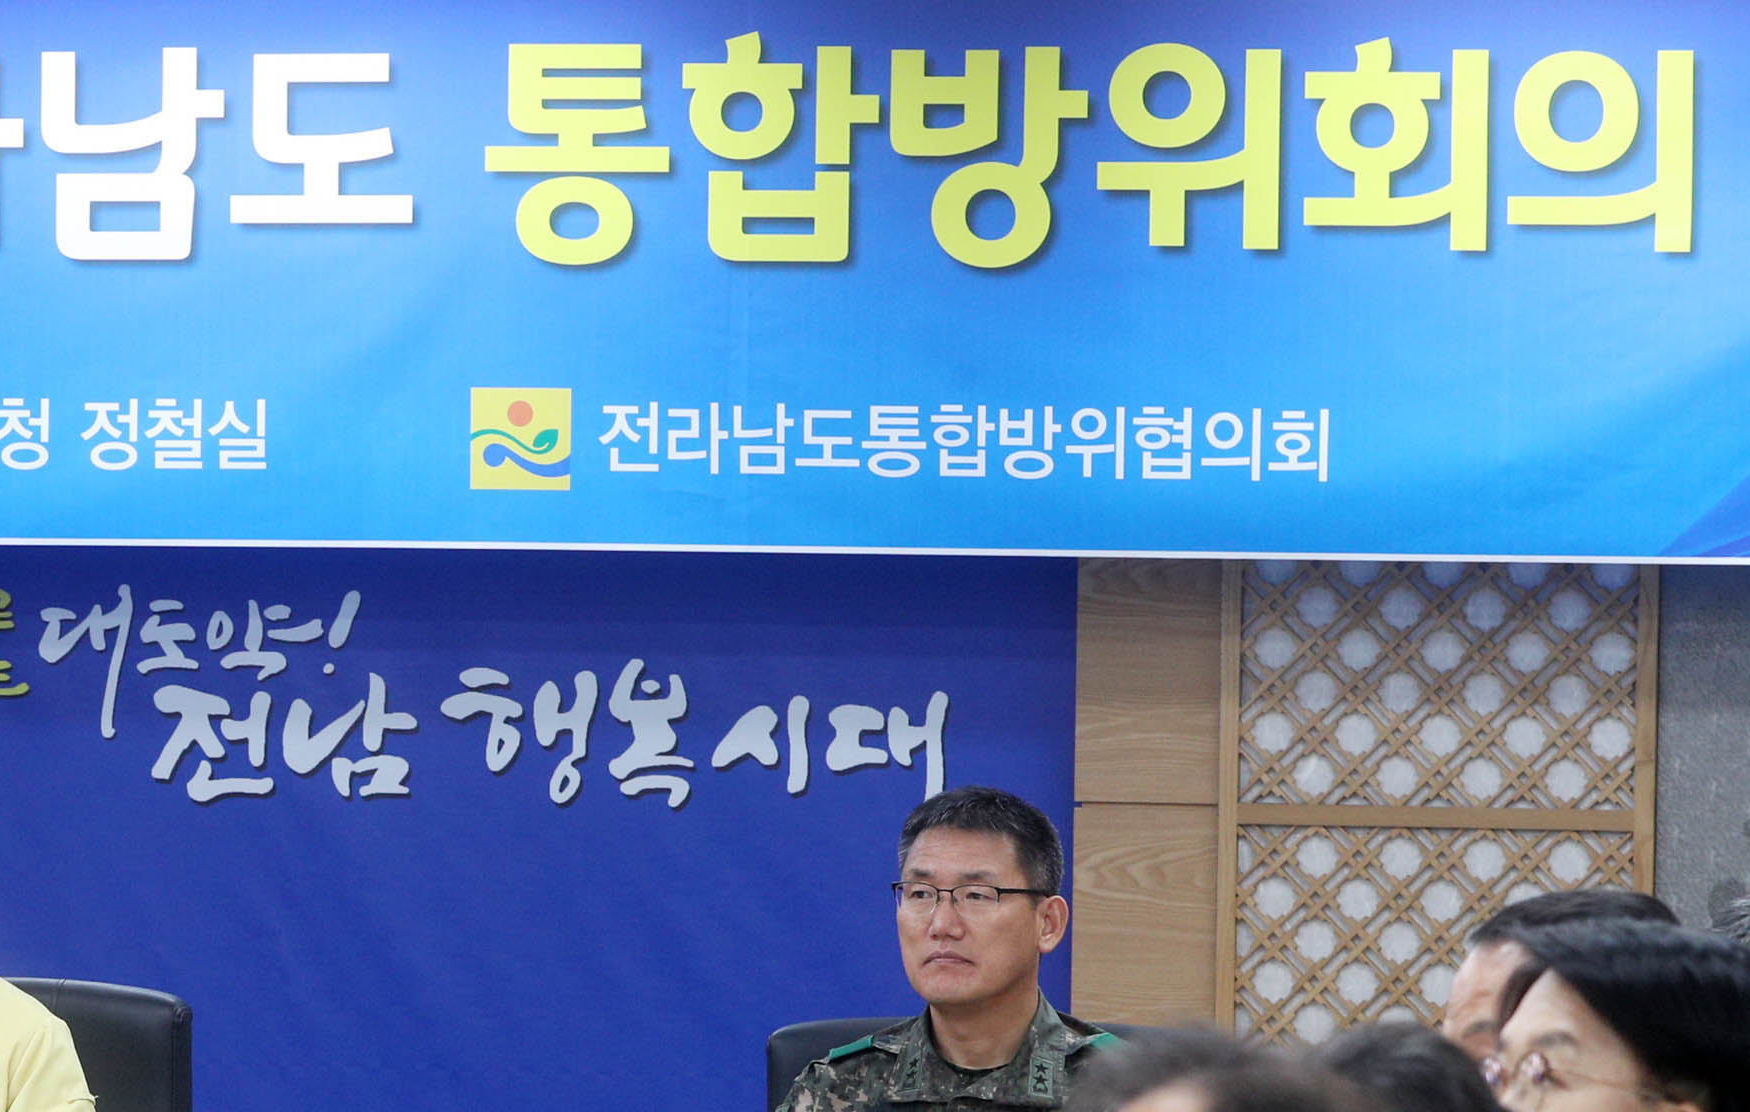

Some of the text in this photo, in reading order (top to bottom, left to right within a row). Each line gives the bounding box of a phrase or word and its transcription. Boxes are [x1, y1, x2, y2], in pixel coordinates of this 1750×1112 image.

[485, 32, 1693, 267] 통합방위회의
[81, 399, 267, 470] 정철실
[599, 402, 1330, 482] 전라남도통합방위협의회
[38, 583, 362, 738] 대도약!
[152, 672, 420, 800] 전남
